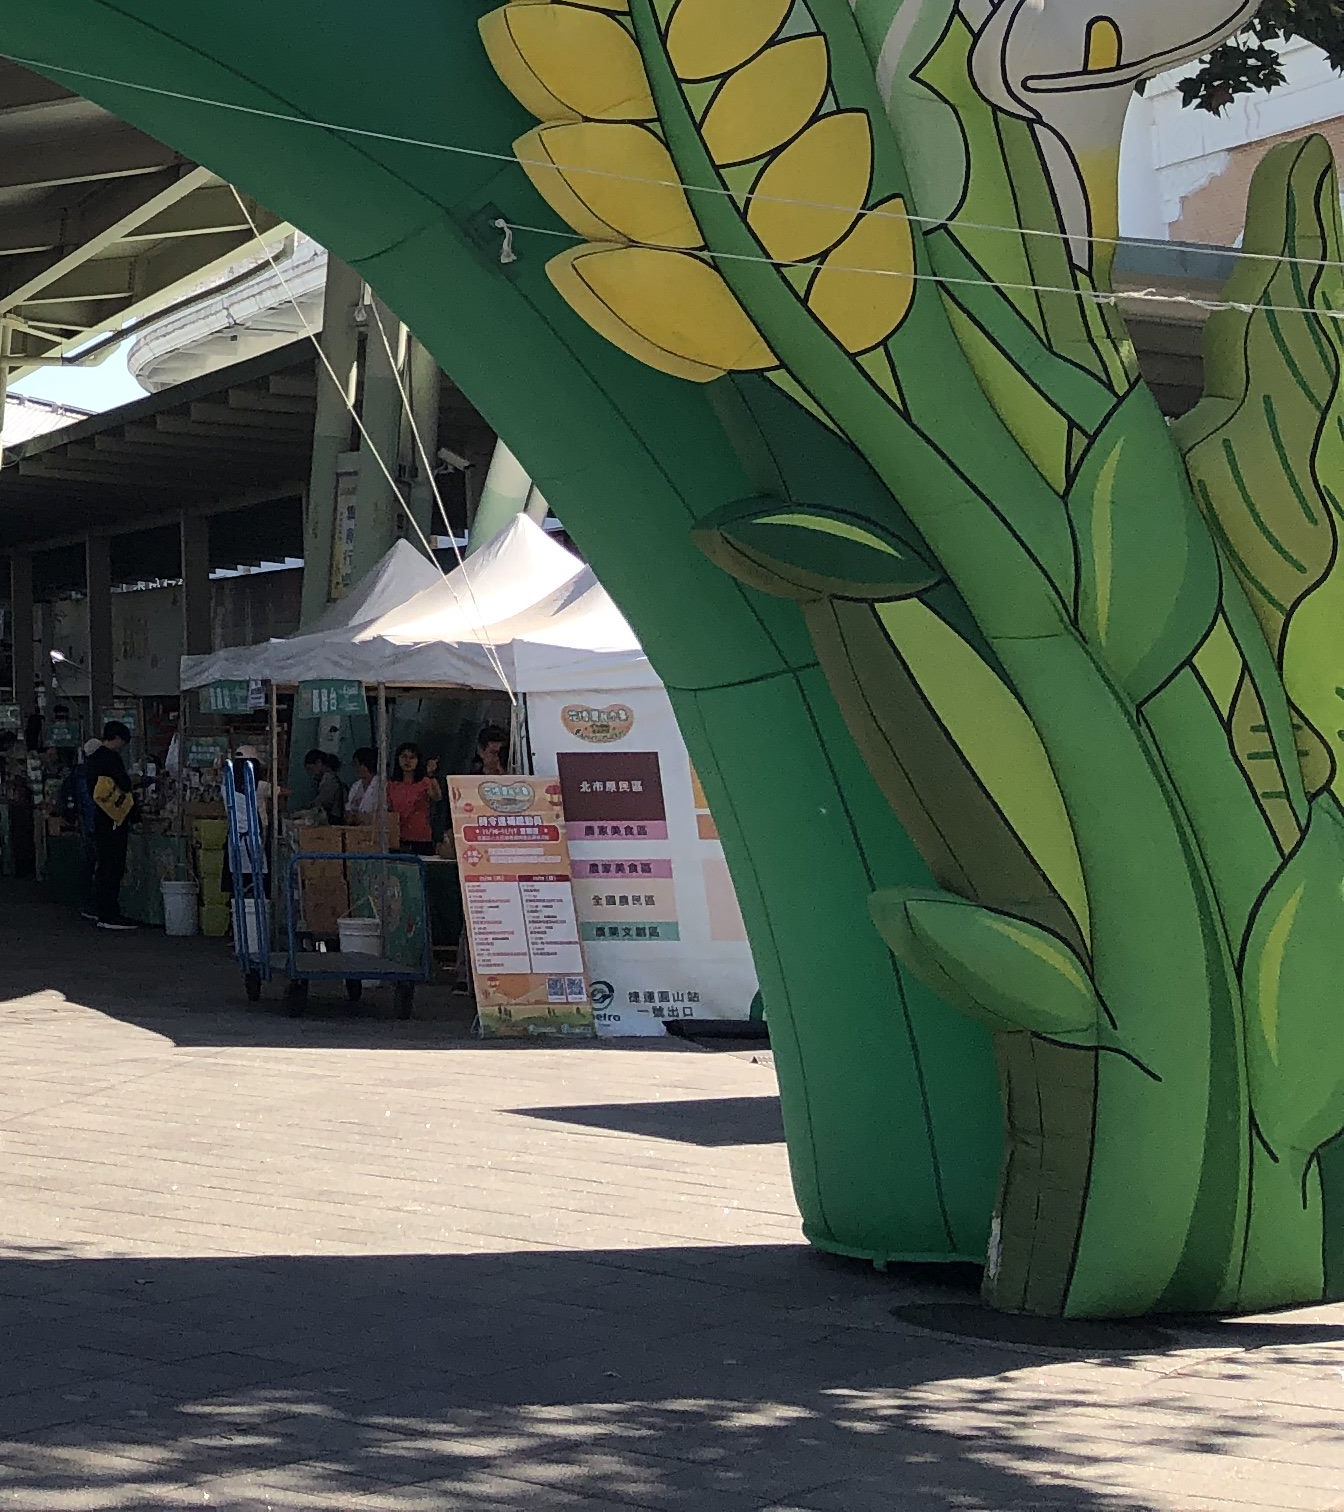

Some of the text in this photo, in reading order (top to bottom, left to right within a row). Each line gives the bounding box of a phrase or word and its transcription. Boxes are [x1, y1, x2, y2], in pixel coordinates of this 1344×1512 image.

[594, 1013, 621, 1023] etro
[637, 1005, 694, 1019] 一號出口
